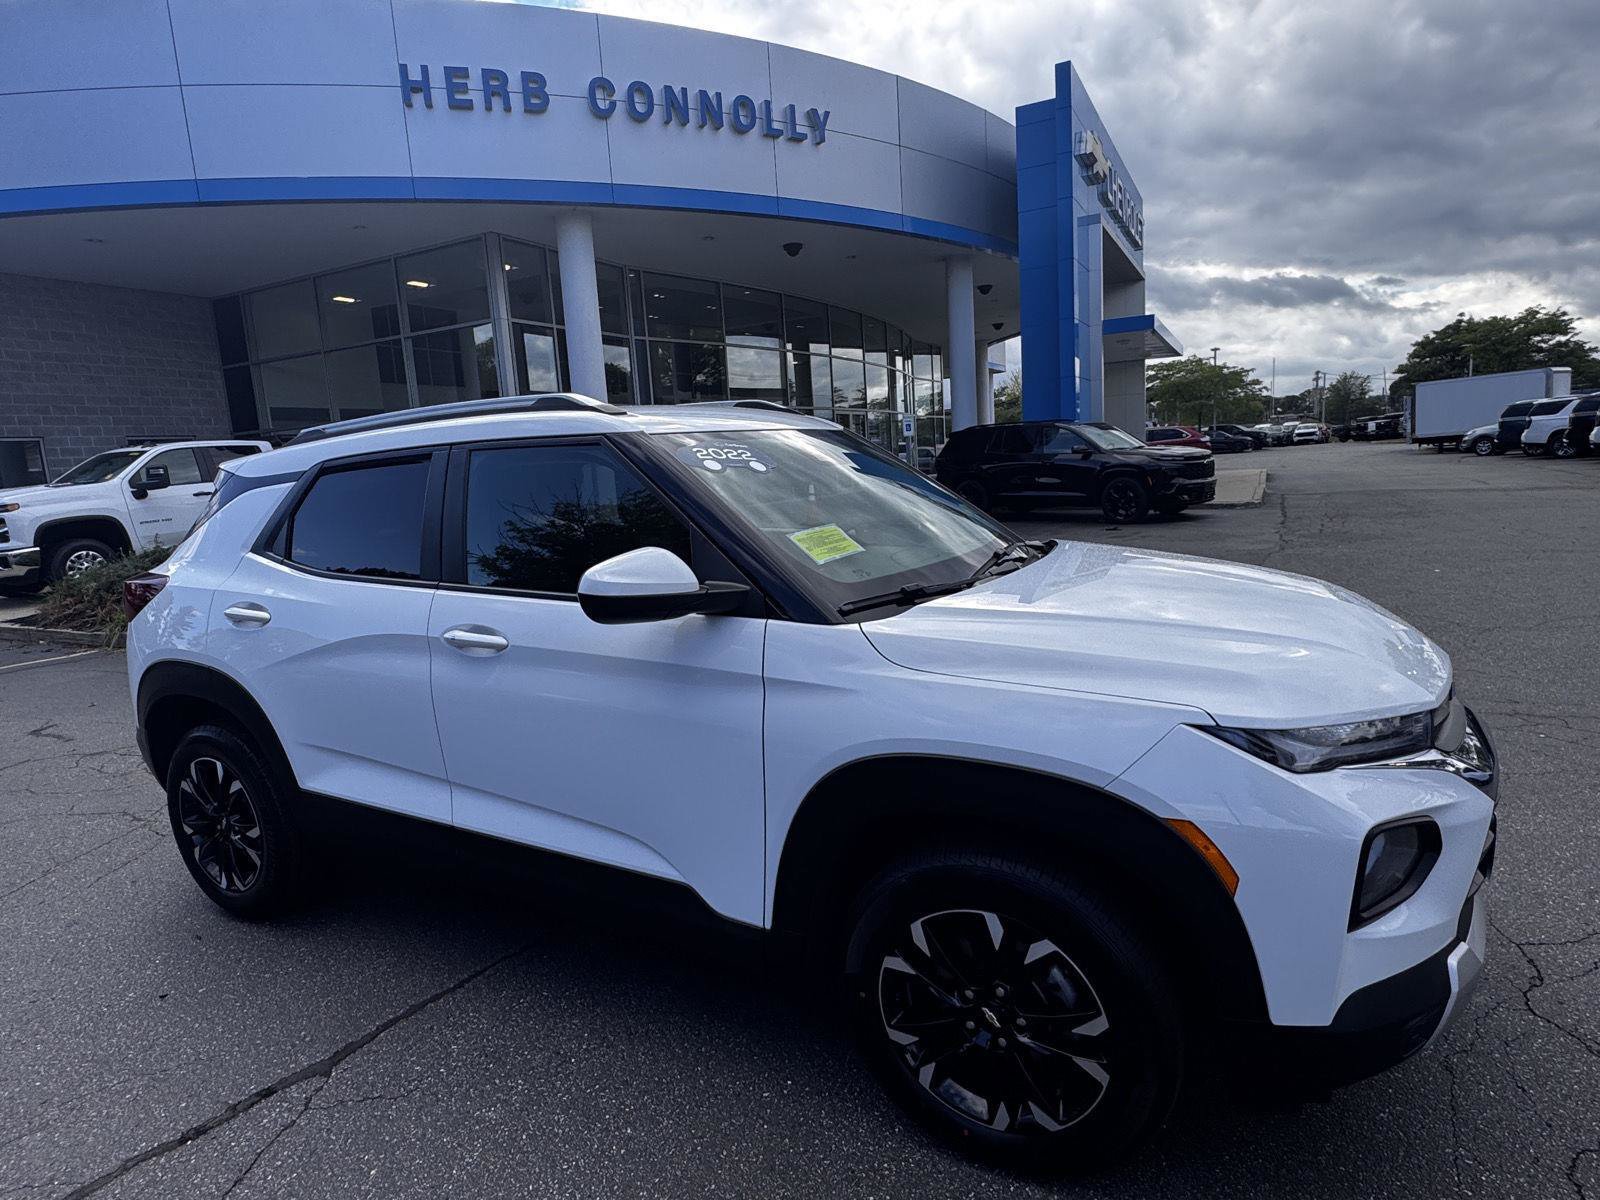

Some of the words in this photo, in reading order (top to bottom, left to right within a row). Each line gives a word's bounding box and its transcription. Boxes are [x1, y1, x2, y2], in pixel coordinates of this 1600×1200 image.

[399, 63, 550, 114] HERB
[587, 76, 831, 146] CONNOLLY
[692, 447, 757, 461] 2022
